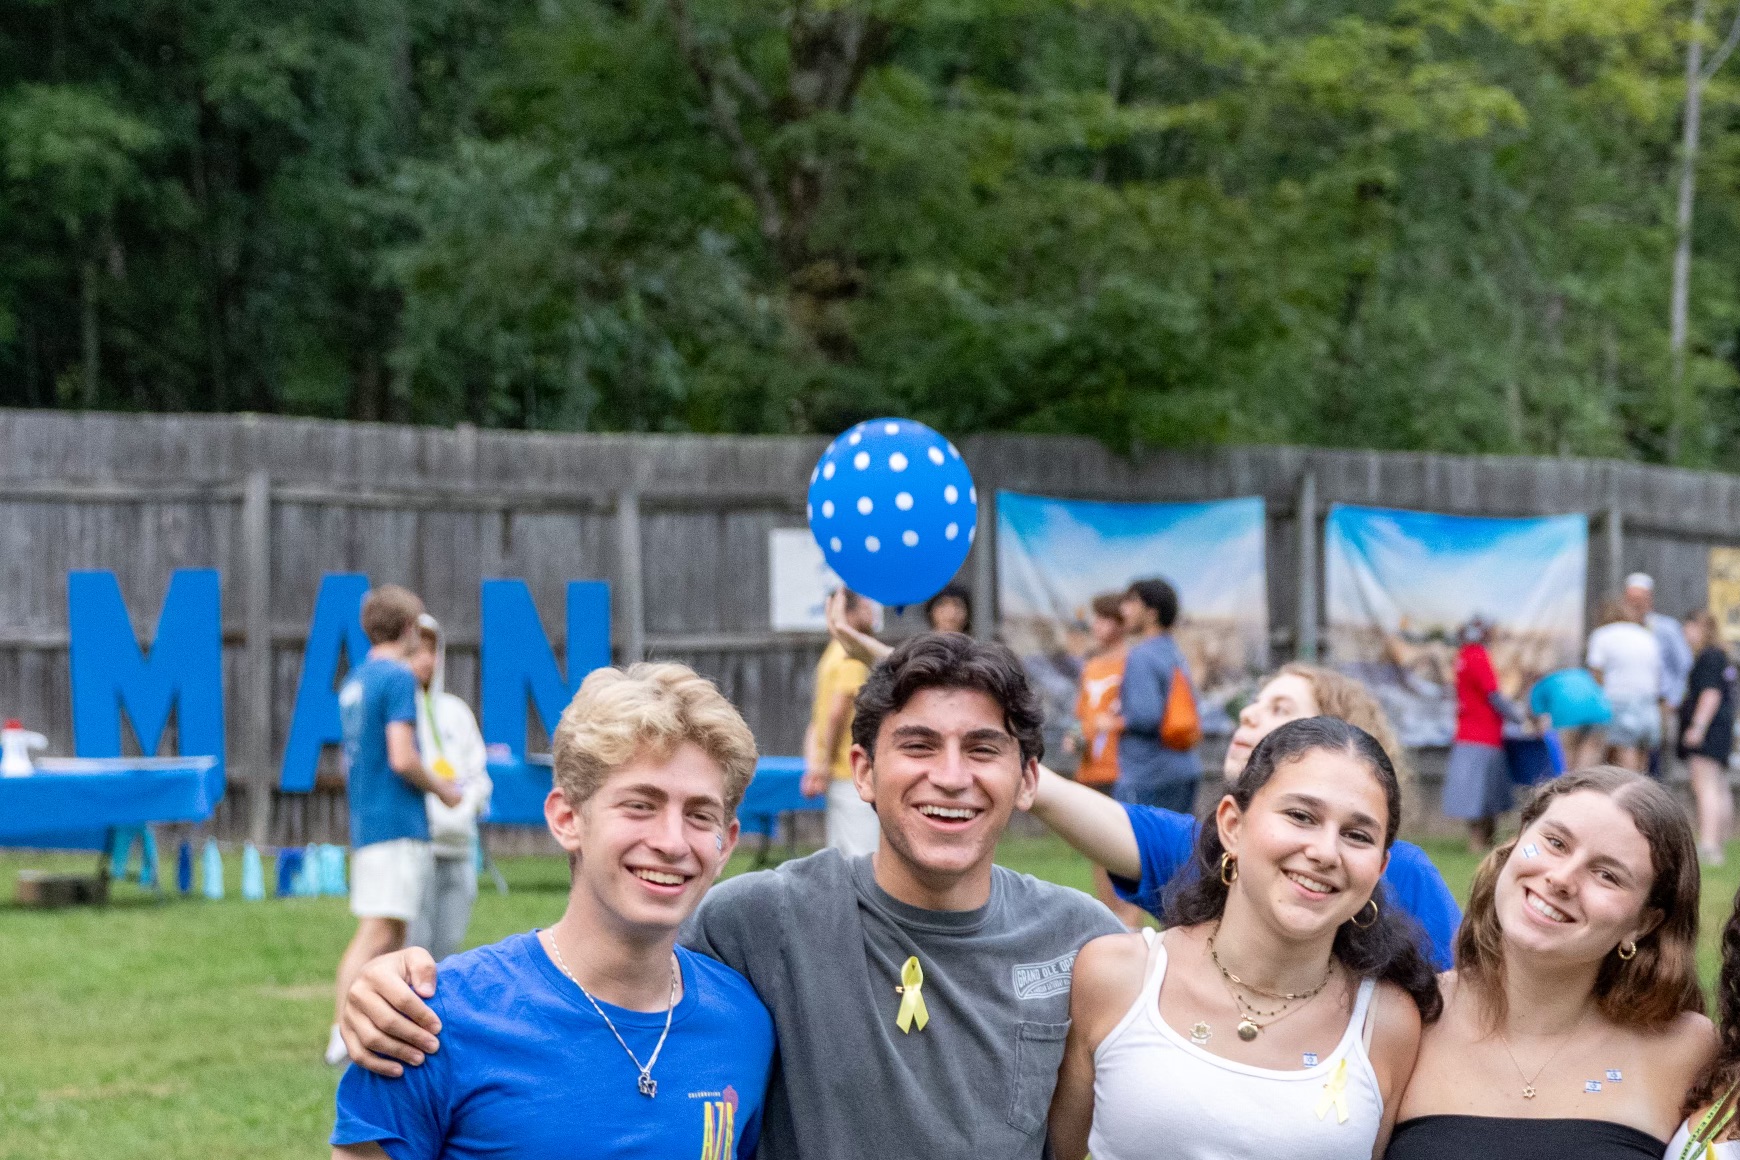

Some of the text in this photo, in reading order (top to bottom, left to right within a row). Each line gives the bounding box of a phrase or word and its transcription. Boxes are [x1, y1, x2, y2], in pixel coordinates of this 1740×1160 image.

[1017, 968, 1040, 988] GRAND
[1042, 965, 1058, 978] OLE
[1059, 956, 1075, 972] OPR
